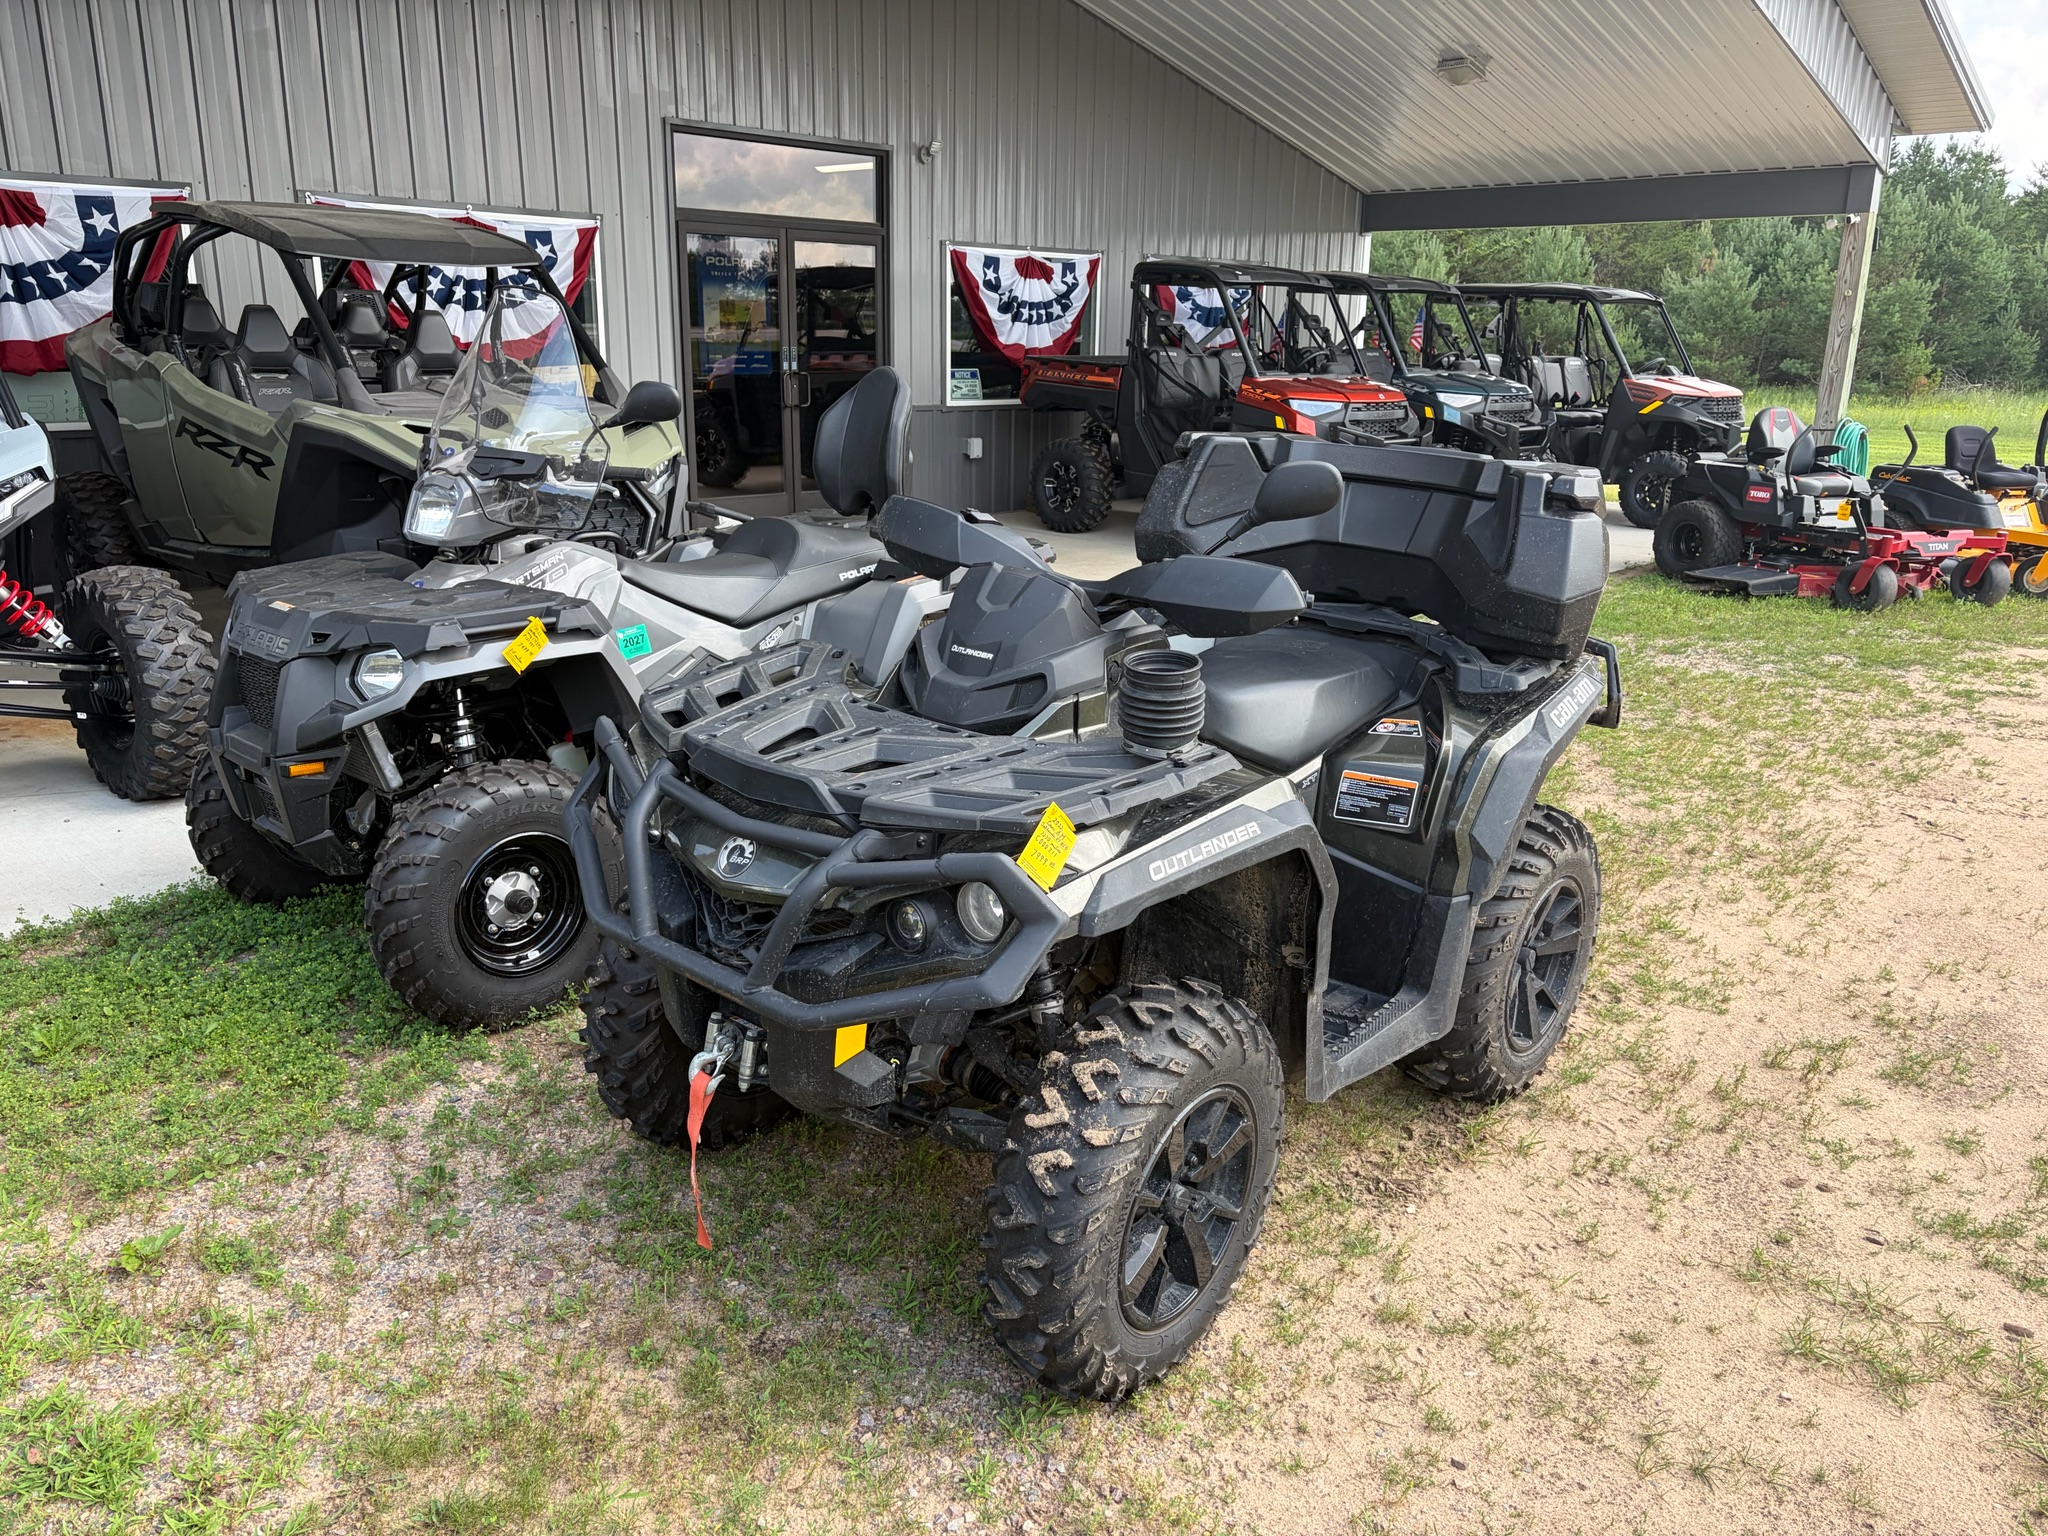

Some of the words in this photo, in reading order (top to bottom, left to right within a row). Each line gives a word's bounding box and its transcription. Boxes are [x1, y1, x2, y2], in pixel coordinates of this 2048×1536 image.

[706, 256, 761, 268] POLARIS
[1038, 369, 1088, 381] RANGER
[258, 387, 292, 396] RZR
[1241, 391, 1265, 401] 1000
[175, 415, 276, 481] RZR
[1749, 490, 1770, 499] TORO
[1928, 542, 1949, 551] TITAN
[237, 622, 291, 656] POLARIS
[623, 633, 645, 649] 2027
[951, 644, 994, 660] OUTLANDER
[1148, 821, 1262, 882] OUTLANDER
[729, 855, 750, 865] BRP
